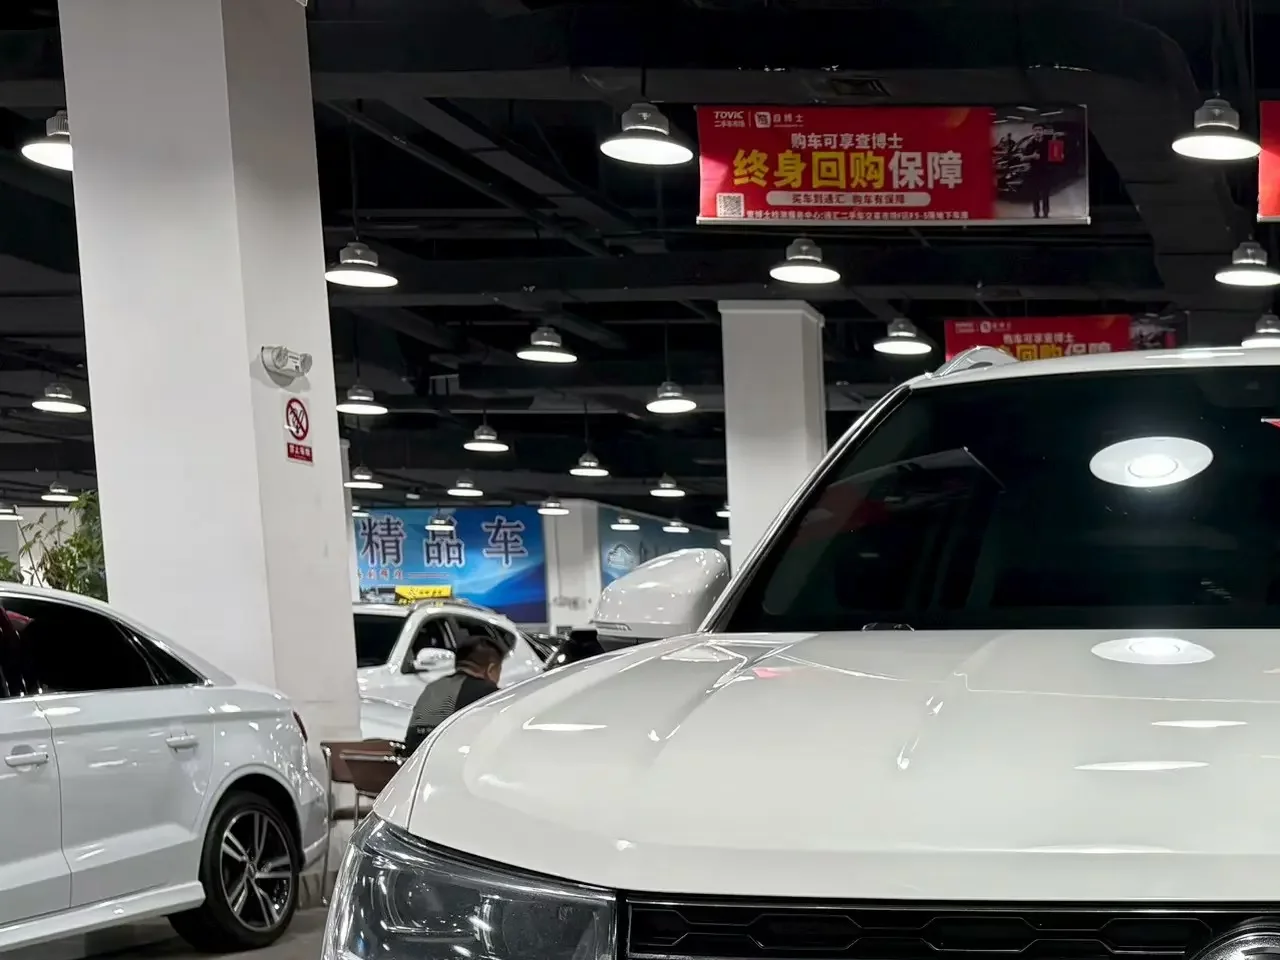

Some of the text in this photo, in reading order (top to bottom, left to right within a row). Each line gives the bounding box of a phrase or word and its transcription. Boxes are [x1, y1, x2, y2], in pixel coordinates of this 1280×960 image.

[713, 110, 744, 119] TOVIC
[791, 132, 904, 149] 购车可享查博士
[733, 149, 963, 189] 终身回购保障
[360, 516, 528, 568] 精品车
